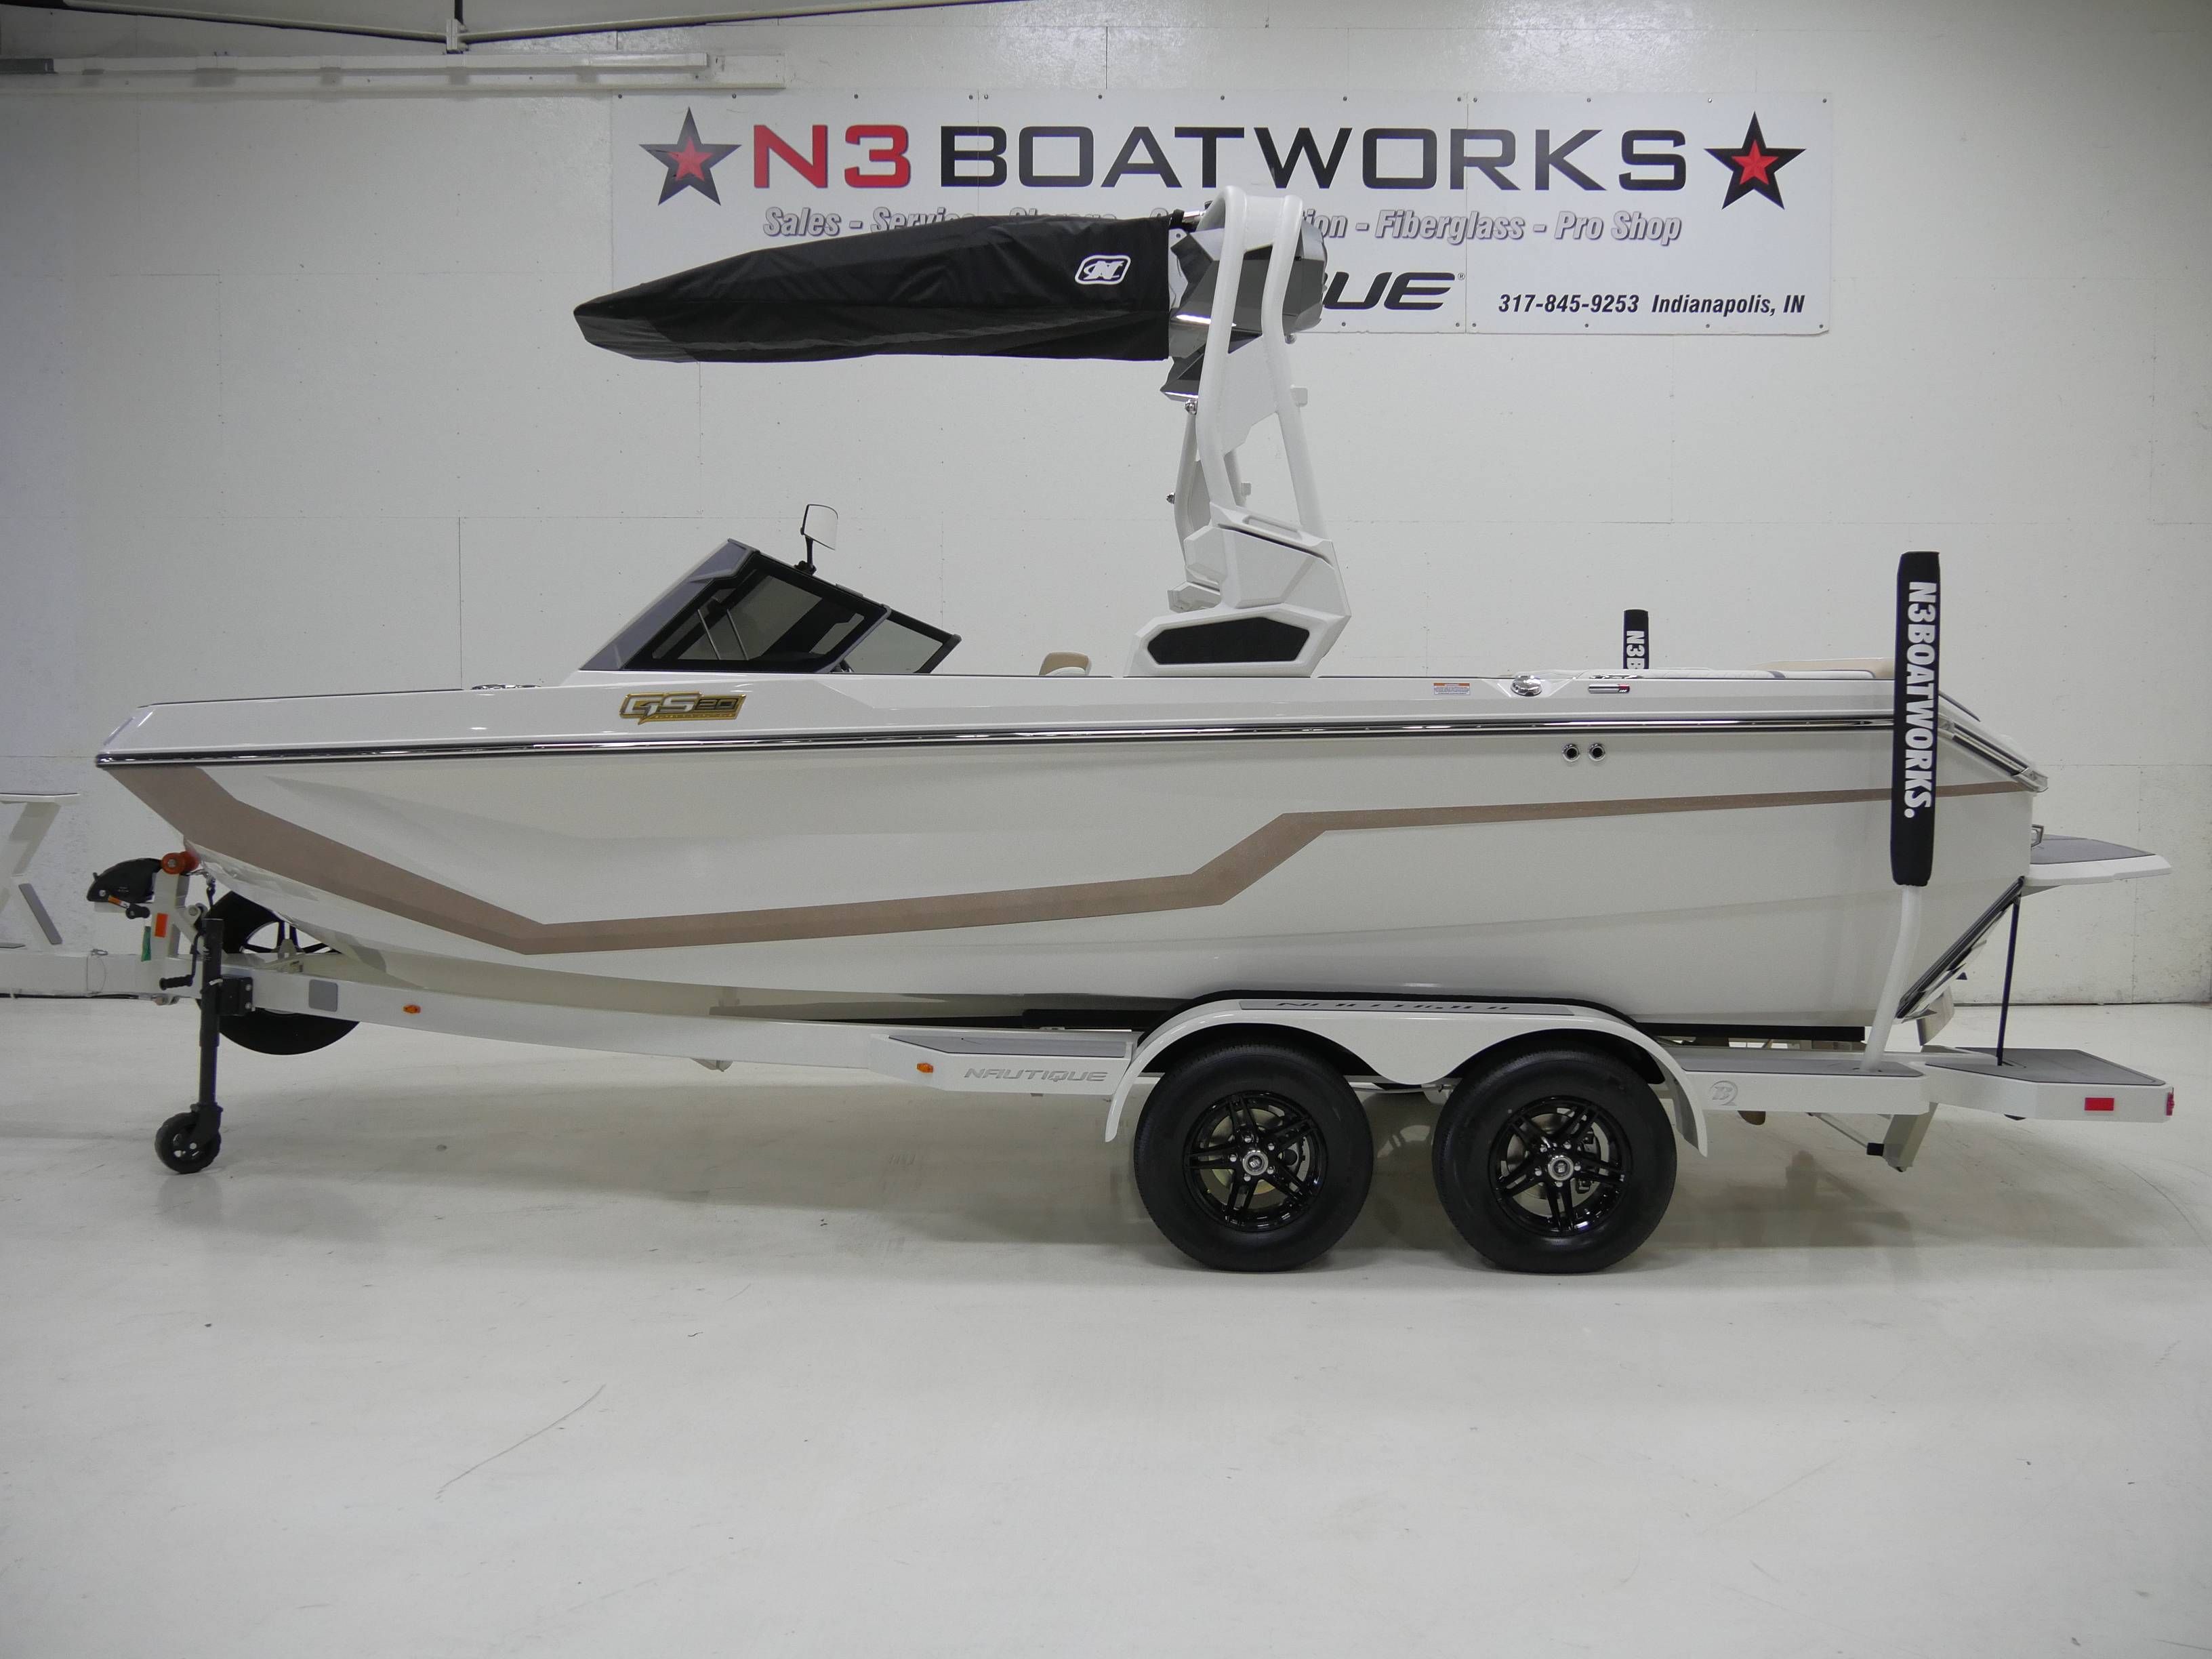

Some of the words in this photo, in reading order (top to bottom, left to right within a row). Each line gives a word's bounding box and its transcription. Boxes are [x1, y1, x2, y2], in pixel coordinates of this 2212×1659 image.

[754, 125, 911, 188] N3
[941, 126, 1686, 190] BOATWORKS
[763, 207, 841, 237] Sales
[1375, 209, 1525, 245] Fiberglass
[1555, 211, 1604, 240] Pro
[1611, 211, 1682, 247] Shop
[1498, 293, 1639, 313] 317-845-9253
[1652, 294, 1776, 317] Indianapolis,
[1783, 295, 1805, 313] IN
[964, 1067, 1108, 1082] NAUTIQUE
